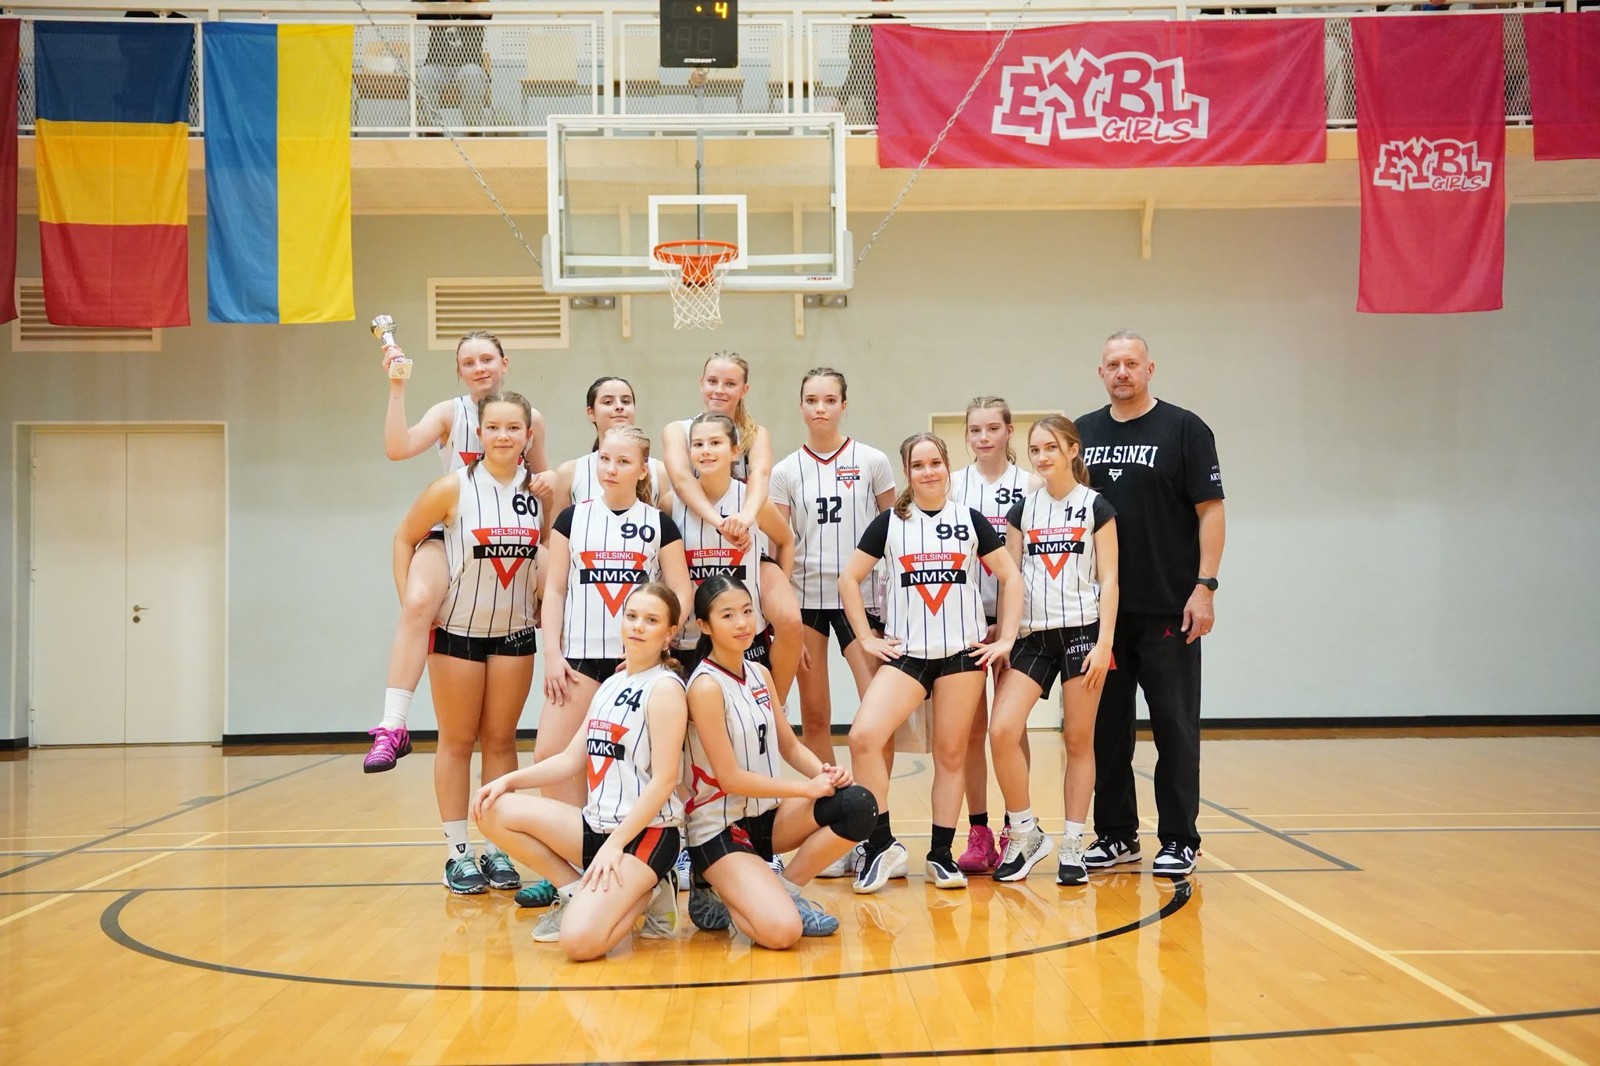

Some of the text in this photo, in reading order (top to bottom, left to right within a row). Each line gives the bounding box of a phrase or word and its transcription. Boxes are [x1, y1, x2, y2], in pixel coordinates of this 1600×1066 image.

[992, 48, 1209, 145] EYBL
[1101, 116, 1192, 144] GIRLS
[1373, 136, 1492, 191] EYBL
[1431, 175, 1483, 192] GIRLS
[1084, 445, 1158, 468] HELSINKI
[995, 487, 1024, 505] 35
[512, 494, 538, 517] 60
[816, 496, 842, 524] 32
[987, 516, 1007, 525] SINKI
[1065, 506, 1087, 522] 14
[491, 528, 530, 536] HELSINKI
[620, 523, 656, 543] 90
[935, 523, 970, 541] 98
[1040, 527, 1072, 535] HELSINKI
[484, 545, 535, 557] NMKY
[595, 551, 634, 560] HELSINKI
[693, 549, 730, 558] HELSINKI
[1035, 542, 1077, 553] NMKY
[913, 553, 952, 562] HELSINKI
[589, 569, 640, 582] NMKY
[689, 567, 737, 578] NMKY
[909, 570, 958, 584] NMKY
[614, 687, 644, 713] 64
